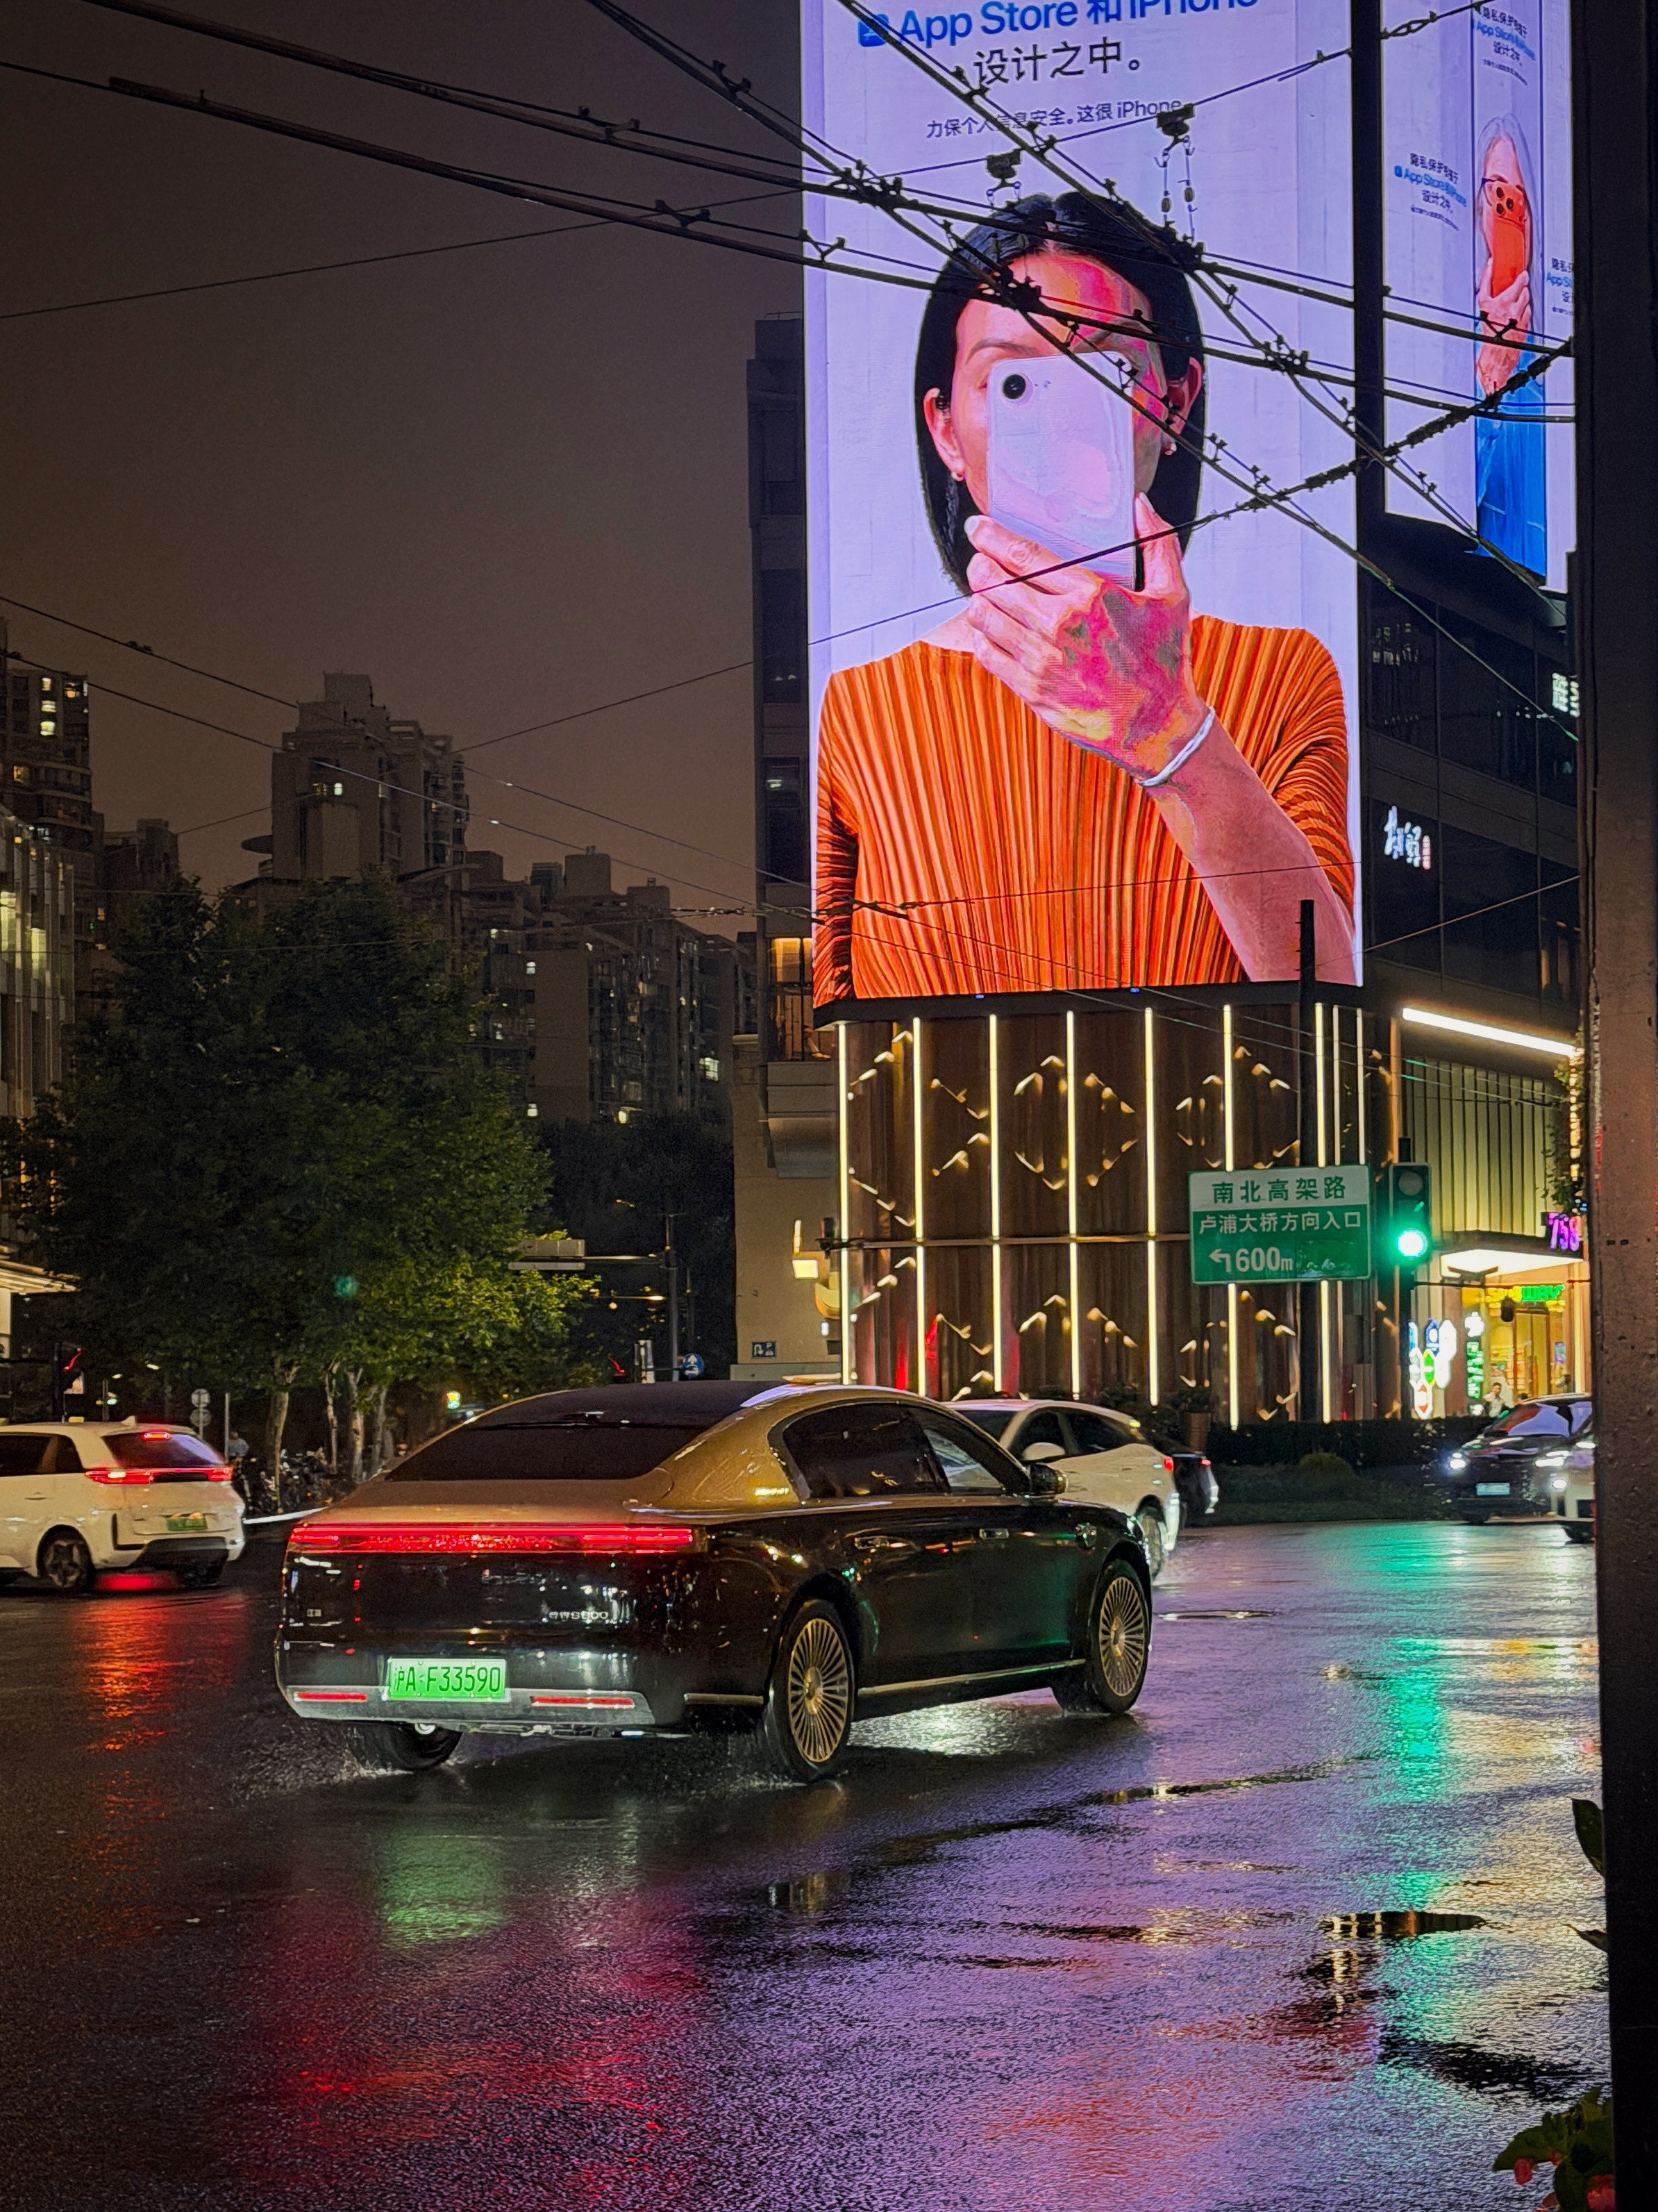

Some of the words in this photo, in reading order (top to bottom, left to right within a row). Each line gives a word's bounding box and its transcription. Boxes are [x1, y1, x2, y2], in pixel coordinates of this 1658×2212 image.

[901, 10, 972, 48] App
[980, 0, 1078, 35] Store
[973, 36, 1140, 85] 设计之中。
[1117, 100, 1182, 119] iPhone
[1212, 1175, 1346, 1204] 南北高架路
[1199, 1211, 1361, 1235] 卢浦大桥方向入口
[1235, 1247, 1293, 1272] 600m
[427, 1666, 501, 1693] F33590
